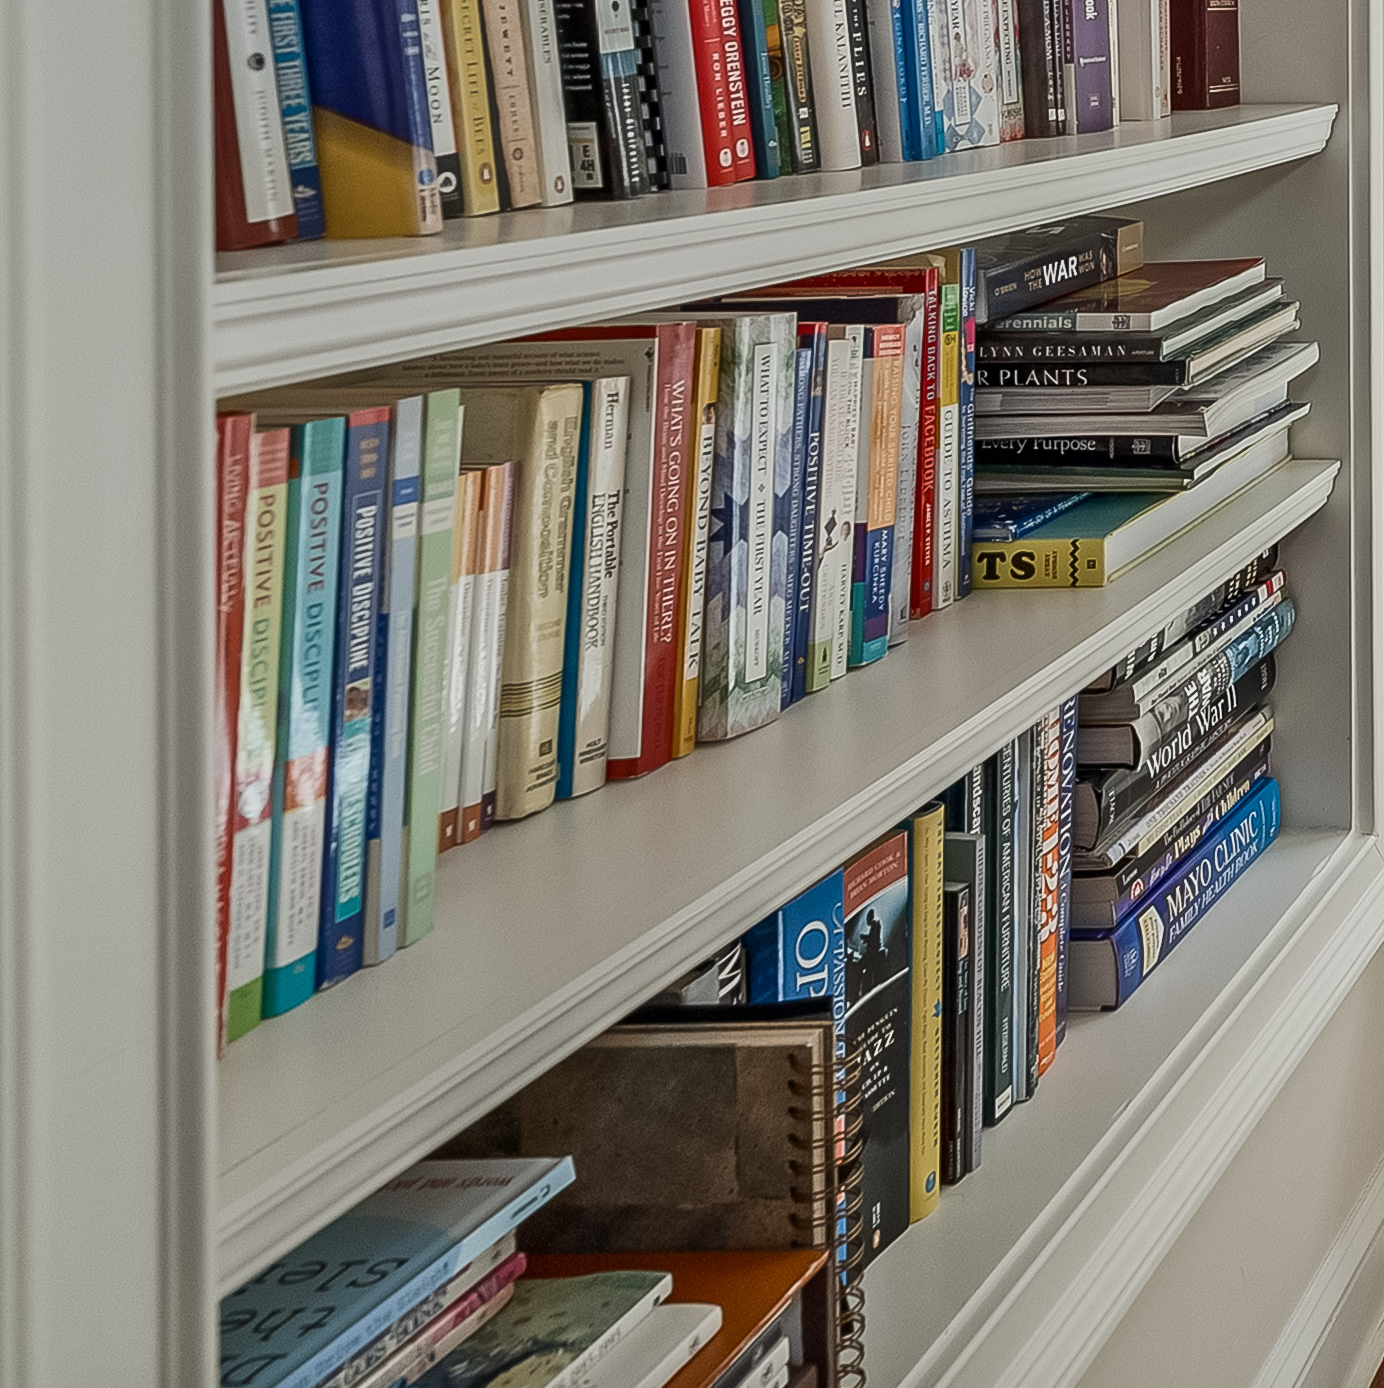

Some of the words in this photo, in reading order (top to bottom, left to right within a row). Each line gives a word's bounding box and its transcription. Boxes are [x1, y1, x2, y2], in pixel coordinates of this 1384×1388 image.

[270, 10, 299, 55] FIRST
[951, 0, 961, 30] YEAR
[275, 59, 306, 112] THREE
[724, 41, 747, 127] ORENSTEIN
[834, 23, 853, 108] KALANITHI
[283, 115, 315, 165] YEARS
[1041, 255, 1078, 287] WAR
[759, 355, 771, 396] WHAT
[999, 367, 1089, 386] PLANTS
[604, 391, 620, 450] Herman
[669, 379, 686, 448] WHAT'S
[758, 398, 769, 417] TO
[757, 419, 769, 474] EXPECT
[981, 435, 1025, 454] Every
[1032, 435, 1097, 454] Purpose
[666, 451, 682, 506] GOING
[697, 436, 713, 531] BEYOND
[803, 431, 821, 516] POSITIVE
[588, 493, 606, 566] ENGLISH
[606, 490, 621, 514] The
[755, 499, 766, 530] THE
[352, 503, 379, 580] POSITIVE
[603, 516, 619, 579] Portable
[663, 550, 676, 568] IN
[664, 516, 678, 548] ON
[753, 532, 765, 580] FIRST
[878, 529, 889, 562] MARY
[691, 540, 707, 598] BABY
[799, 523, 816, 613] TIME-OUT
[877, 566, 888, 612] SHEEDY
[584, 559, 603, 653] HANDBOOK
[660, 576, 676, 644] THERE?
[752, 581, 764, 616] YEAR
[347, 581, 375, 672] DISCIPLINE
[687, 610, 704, 669] TALK
[1146, 722, 1193, 779] World
[1196, 698, 1226, 738] War
[1226, 684, 1238, 713] II
[1059, 696, 1077, 880] RENOVATION
[1214, 779, 1250, 821] Children
[1166, 858, 1213, 923] MAYO
[1213, 811, 1258, 876] CLINIC
[1174, 825, 1201, 860] Plays
[1167, 897, 1201, 944] FAMILY
[1200, 865, 1235, 910] HEALTH
[1234, 838, 1259, 879] BOOK
